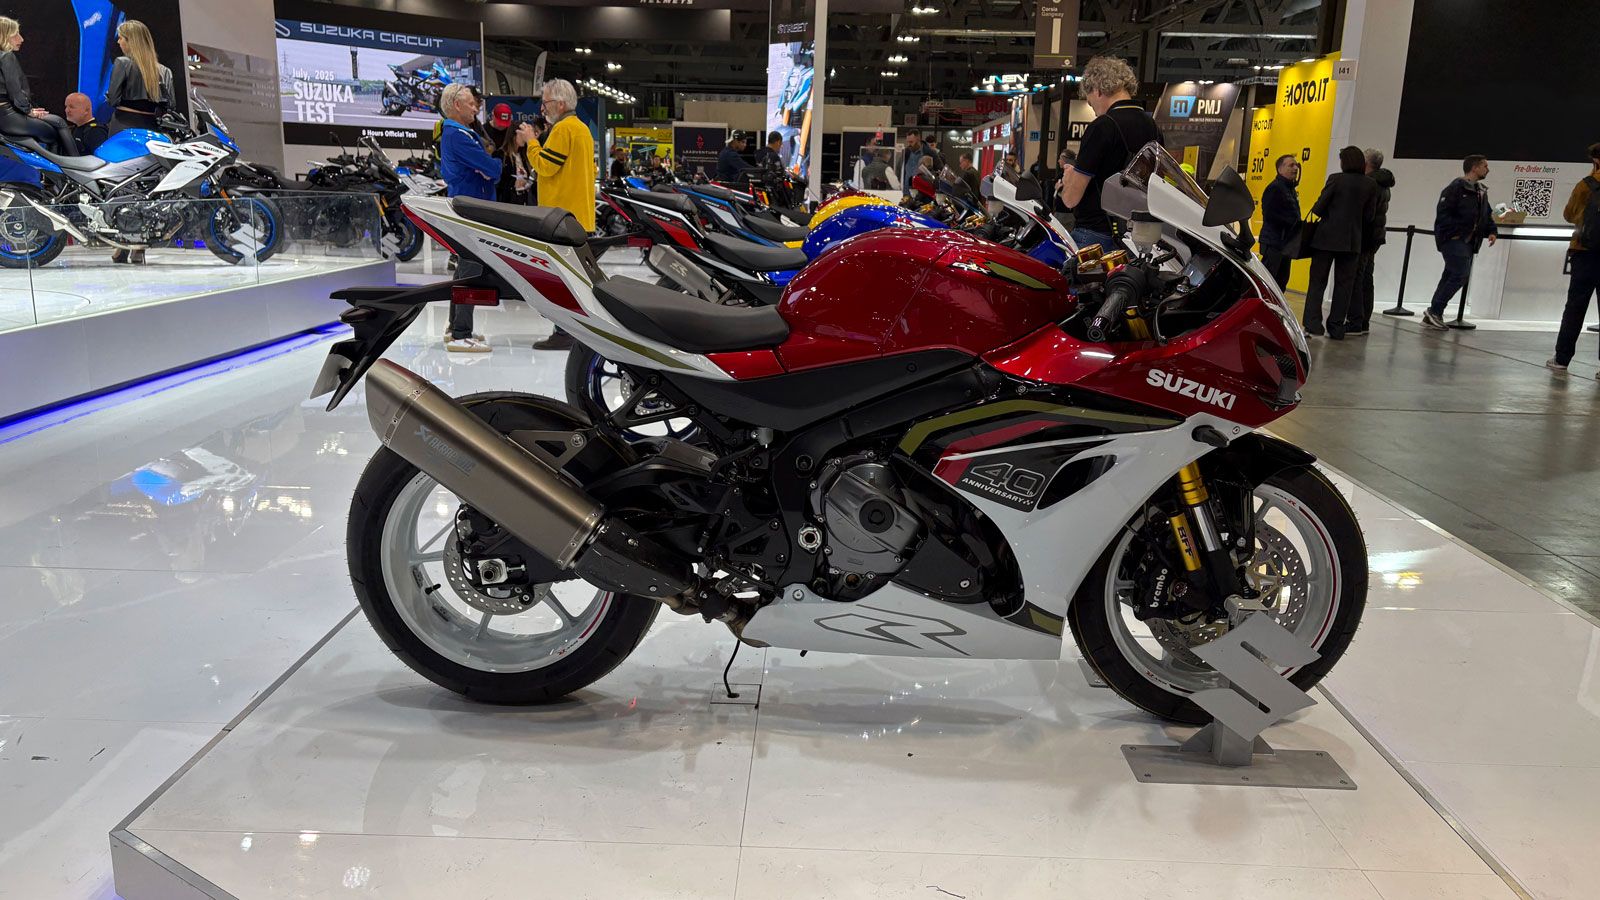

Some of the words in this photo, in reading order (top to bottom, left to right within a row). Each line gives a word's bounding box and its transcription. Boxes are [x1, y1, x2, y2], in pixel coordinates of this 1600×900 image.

[300, 22, 375, 41] SUZUKA
[379, 32, 443, 48] CIRCUIT
[292, 67, 311, 80] July,
[314, 70, 335, 81] 2025
[293, 81, 354, 104] SUZUKA
[1283, 77, 1329, 107] MOTO.IT
[294, 101, 336, 124] TEST
[1197, 99, 1222, 115] PMJ
[1146, 368, 1237, 411] SUZUKI
[962, 477, 1025, 503] ANNIVERSARY
[970, 462, 1045, 498] 40
[1149, 568, 1168, 608] brembo
